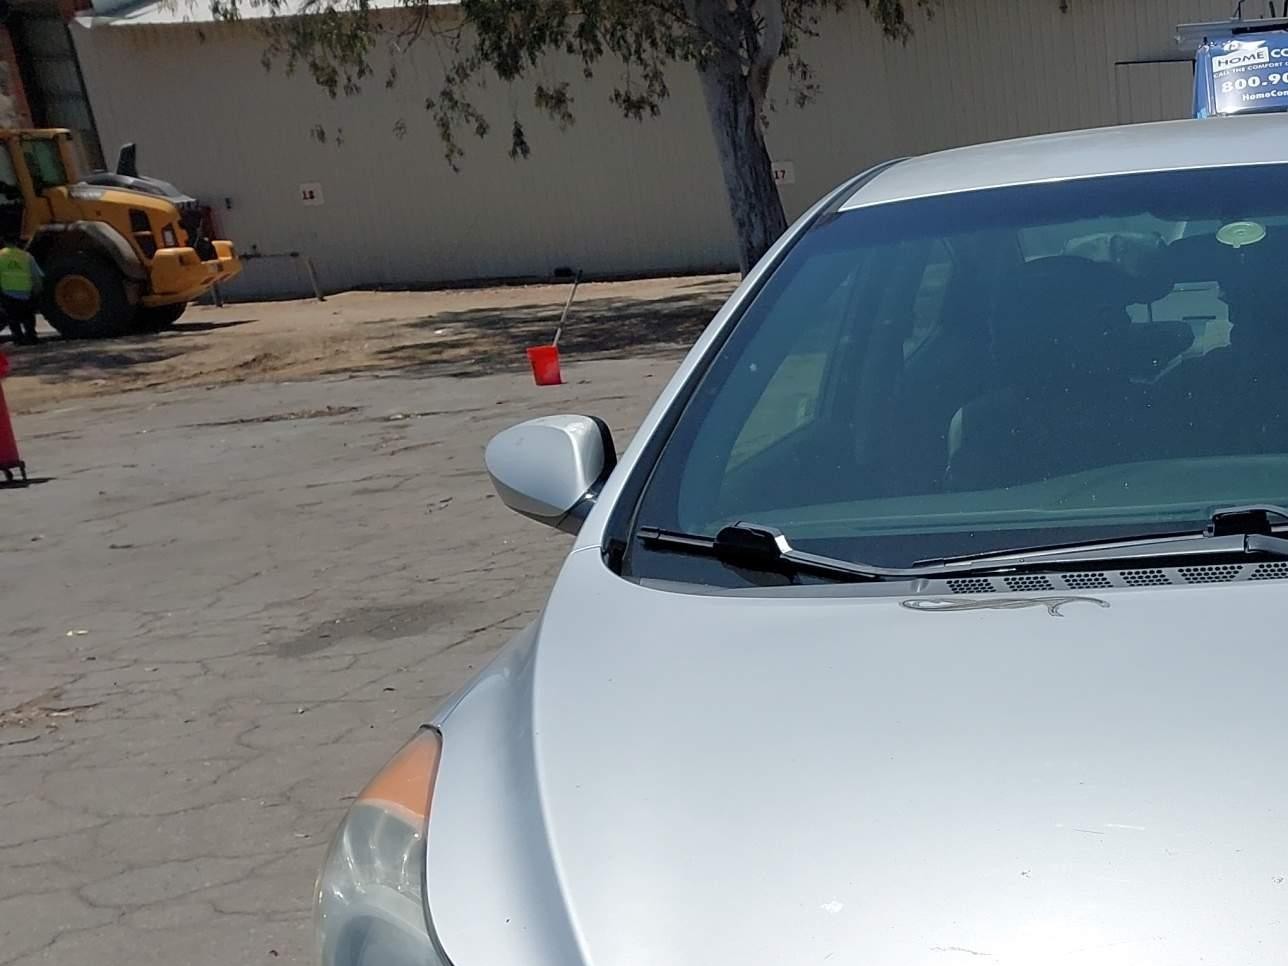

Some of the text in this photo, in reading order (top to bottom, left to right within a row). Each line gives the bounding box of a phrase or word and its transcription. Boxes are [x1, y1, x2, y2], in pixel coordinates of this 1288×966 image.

[1217, 51, 1265, 67] HOME
[1247, 61, 1283, 71] COMFORT
[774, 169, 786, 180] 17
